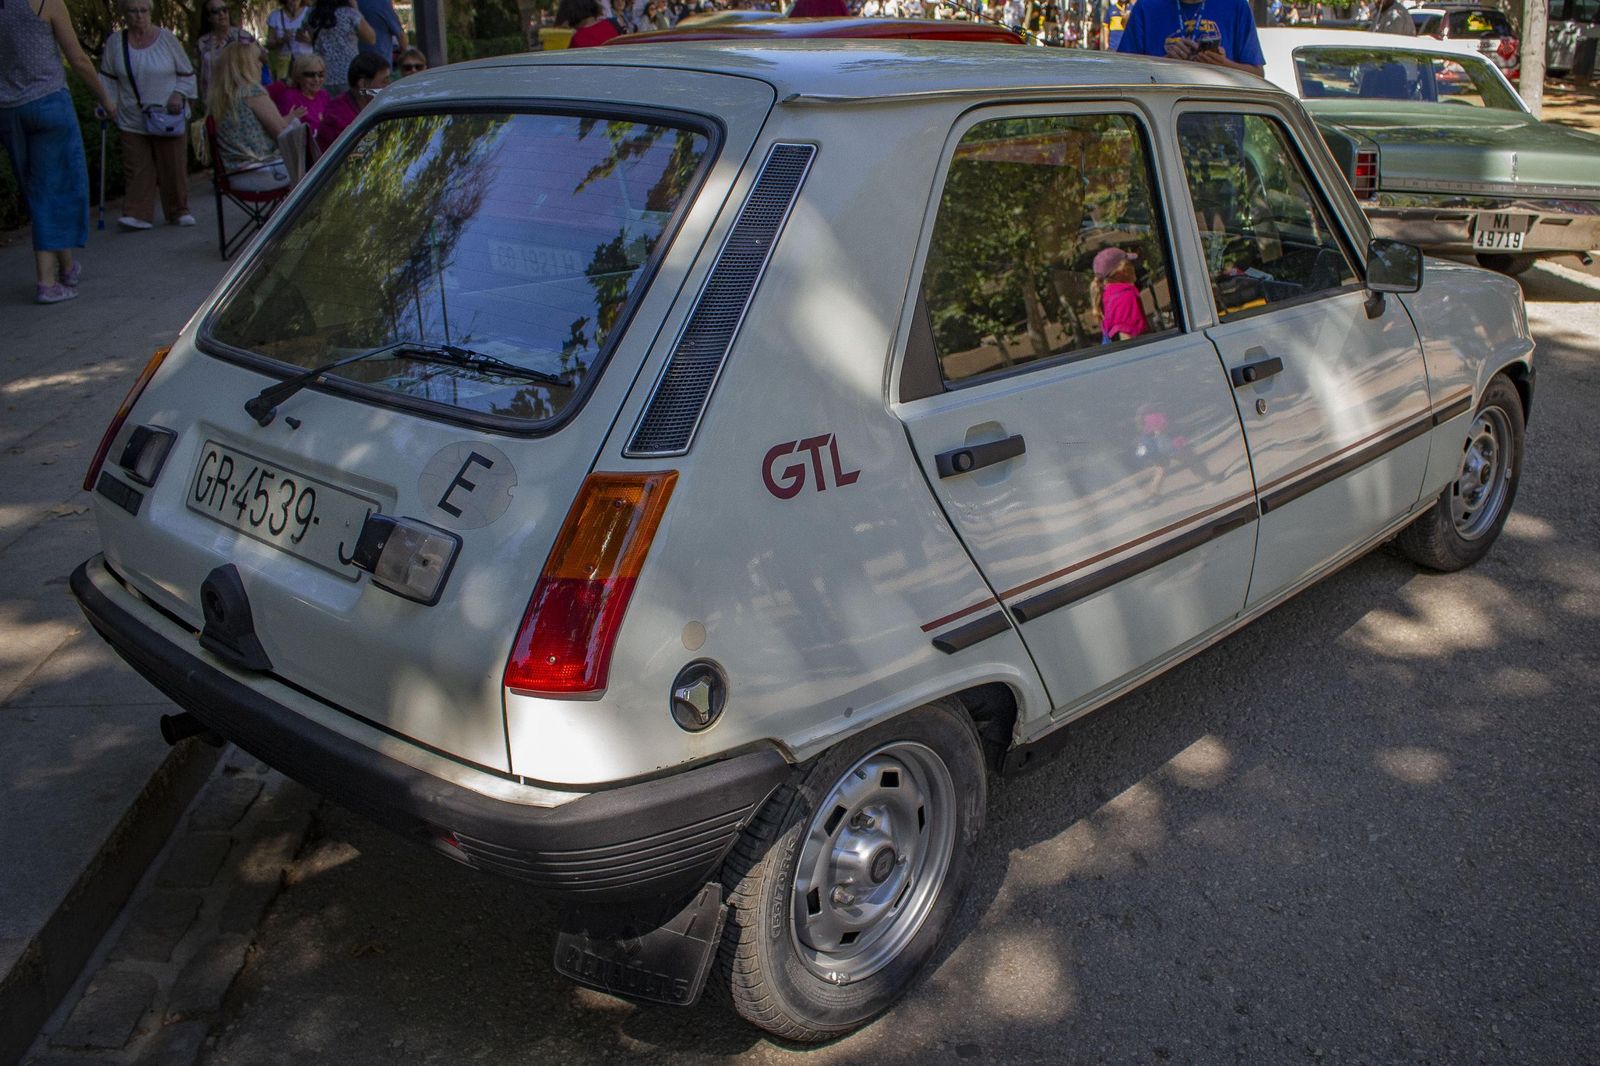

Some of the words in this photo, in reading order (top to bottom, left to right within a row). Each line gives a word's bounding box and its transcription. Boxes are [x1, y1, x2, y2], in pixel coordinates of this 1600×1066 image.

[1477, 230, 1521, 248] 49719
[1493, 213, 1509, 230] NA
[437, 450, 494, 519] E
[761, 432, 862, 500] GTL
